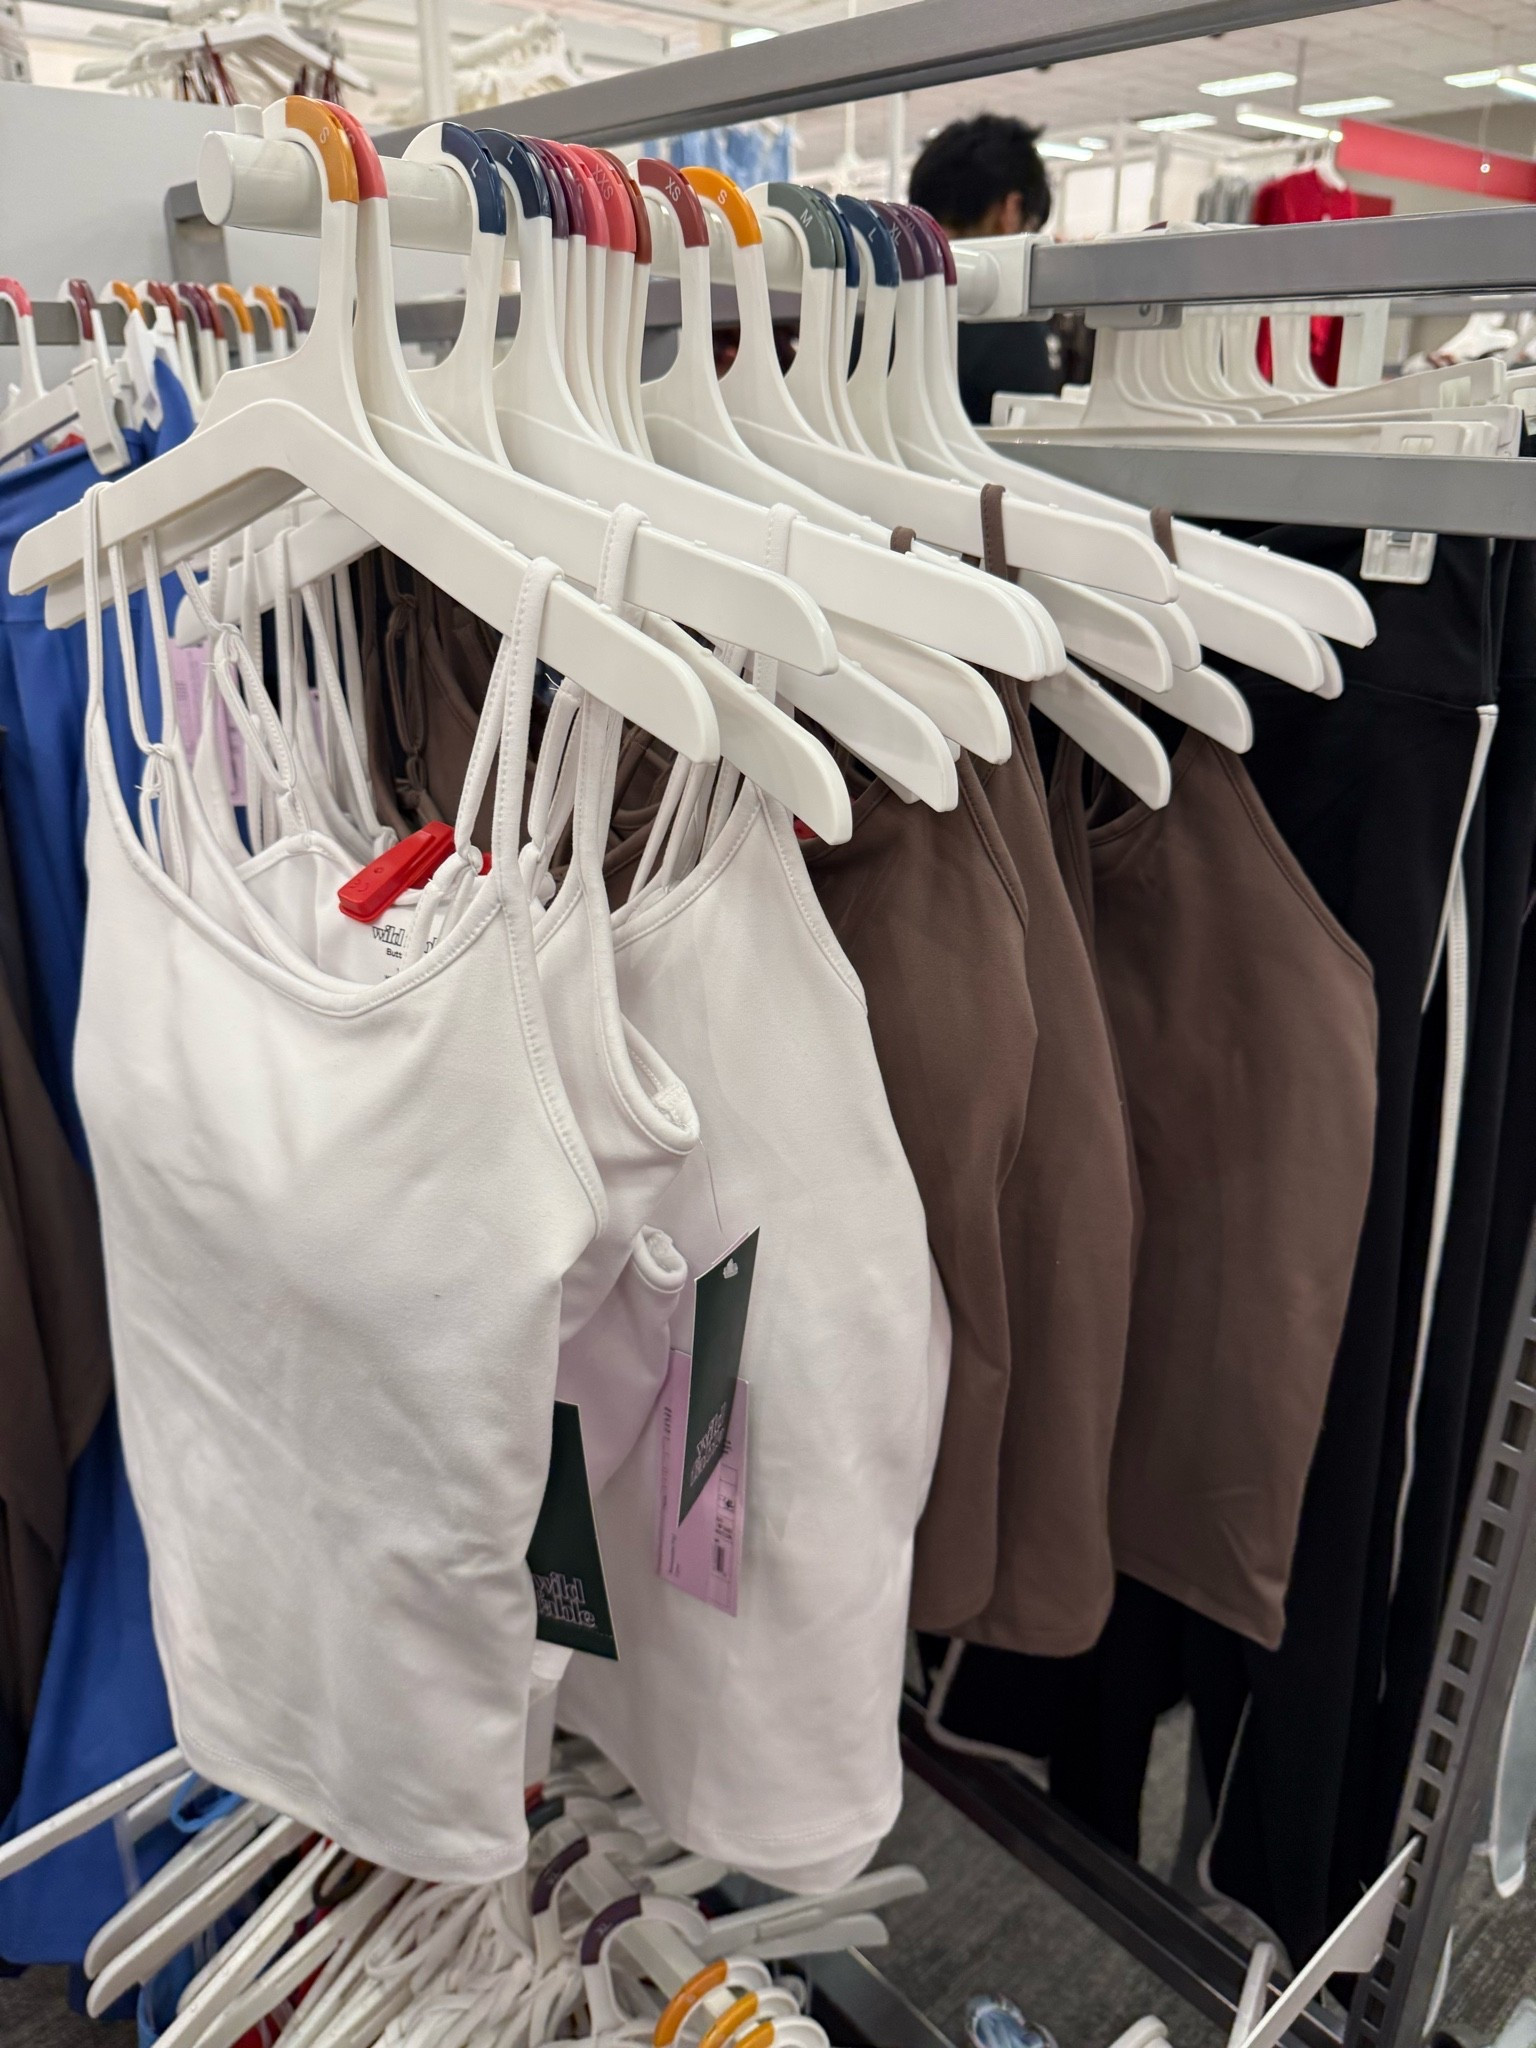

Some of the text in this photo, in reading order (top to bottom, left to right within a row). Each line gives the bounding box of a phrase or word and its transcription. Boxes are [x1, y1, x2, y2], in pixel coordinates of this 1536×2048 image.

[319, 126, 330, 144] S
[506, 145, 515, 165] L
[470, 158, 480, 179] L
[592, 163, 614, 201] XXS
[665, 176, 682, 202] XS
[717, 188, 728, 205] S
[799, 208, 813, 228] M
[867, 227, 878, 243] L
[888, 222, 902, 246] XL
[372, 924, 406, 947] wild
[386, 947, 403, 959] Butt
[537, 1590, 597, 1629] able
